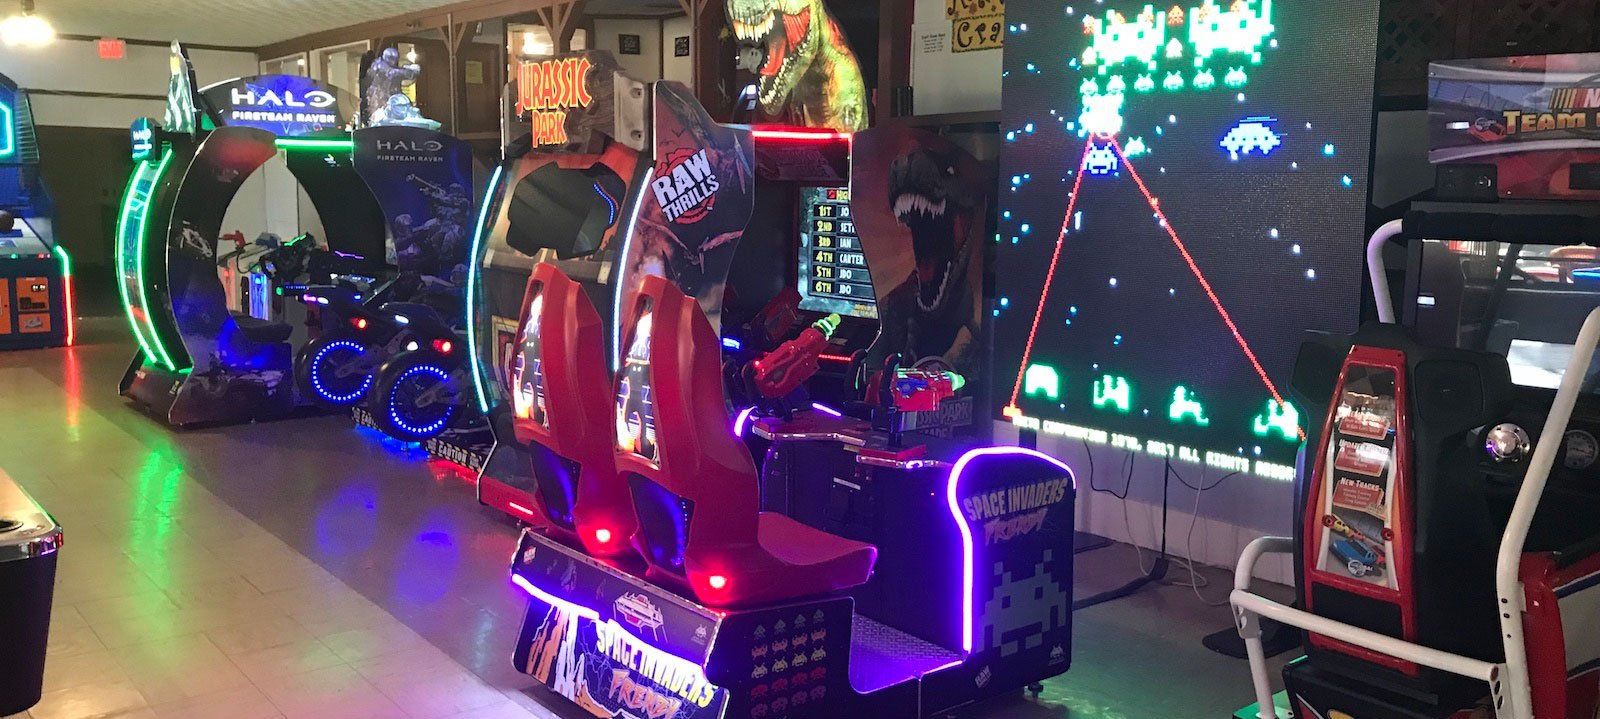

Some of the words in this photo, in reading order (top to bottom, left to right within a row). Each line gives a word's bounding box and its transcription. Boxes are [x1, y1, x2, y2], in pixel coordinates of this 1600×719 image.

[515, 57, 592, 117] JURASSIC
[231, 88, 336, 107] HALO
[232, 110, 289, 122] FIRETEAM
[296, 113, 336, 123] RAVEN
[1503, 110, 1586, 134] TEAM
[532, 111, 567, 148] PARK
[376, 140, 443, 151] HALO
[651, 149, 712, 208] RAW
[662, 174, 719, 222] THRILLS
[819, 206, 832, 217] 1ST
[817, 221, 832, 232] 2ND
[818, 236, 831, 247] 3RD
[840, 238, 851, 248] IAN
[816, 251, 833, 263] 4TH
[840, 253, 864, 265] CARTER
[816, 267, 832, 277] 5TH
[815, 281, 832, 293] 6TH
[439, 444, 467, 463] CAUTION
[963, 490, 1006, 521] SPACE
[1008, 478, 1068, 513] INVADERS
[596, 619, 642, 671] SPACE
[639, 640, 718, 708] INVADERS
[608, 668, 680, 719] FRENZY
